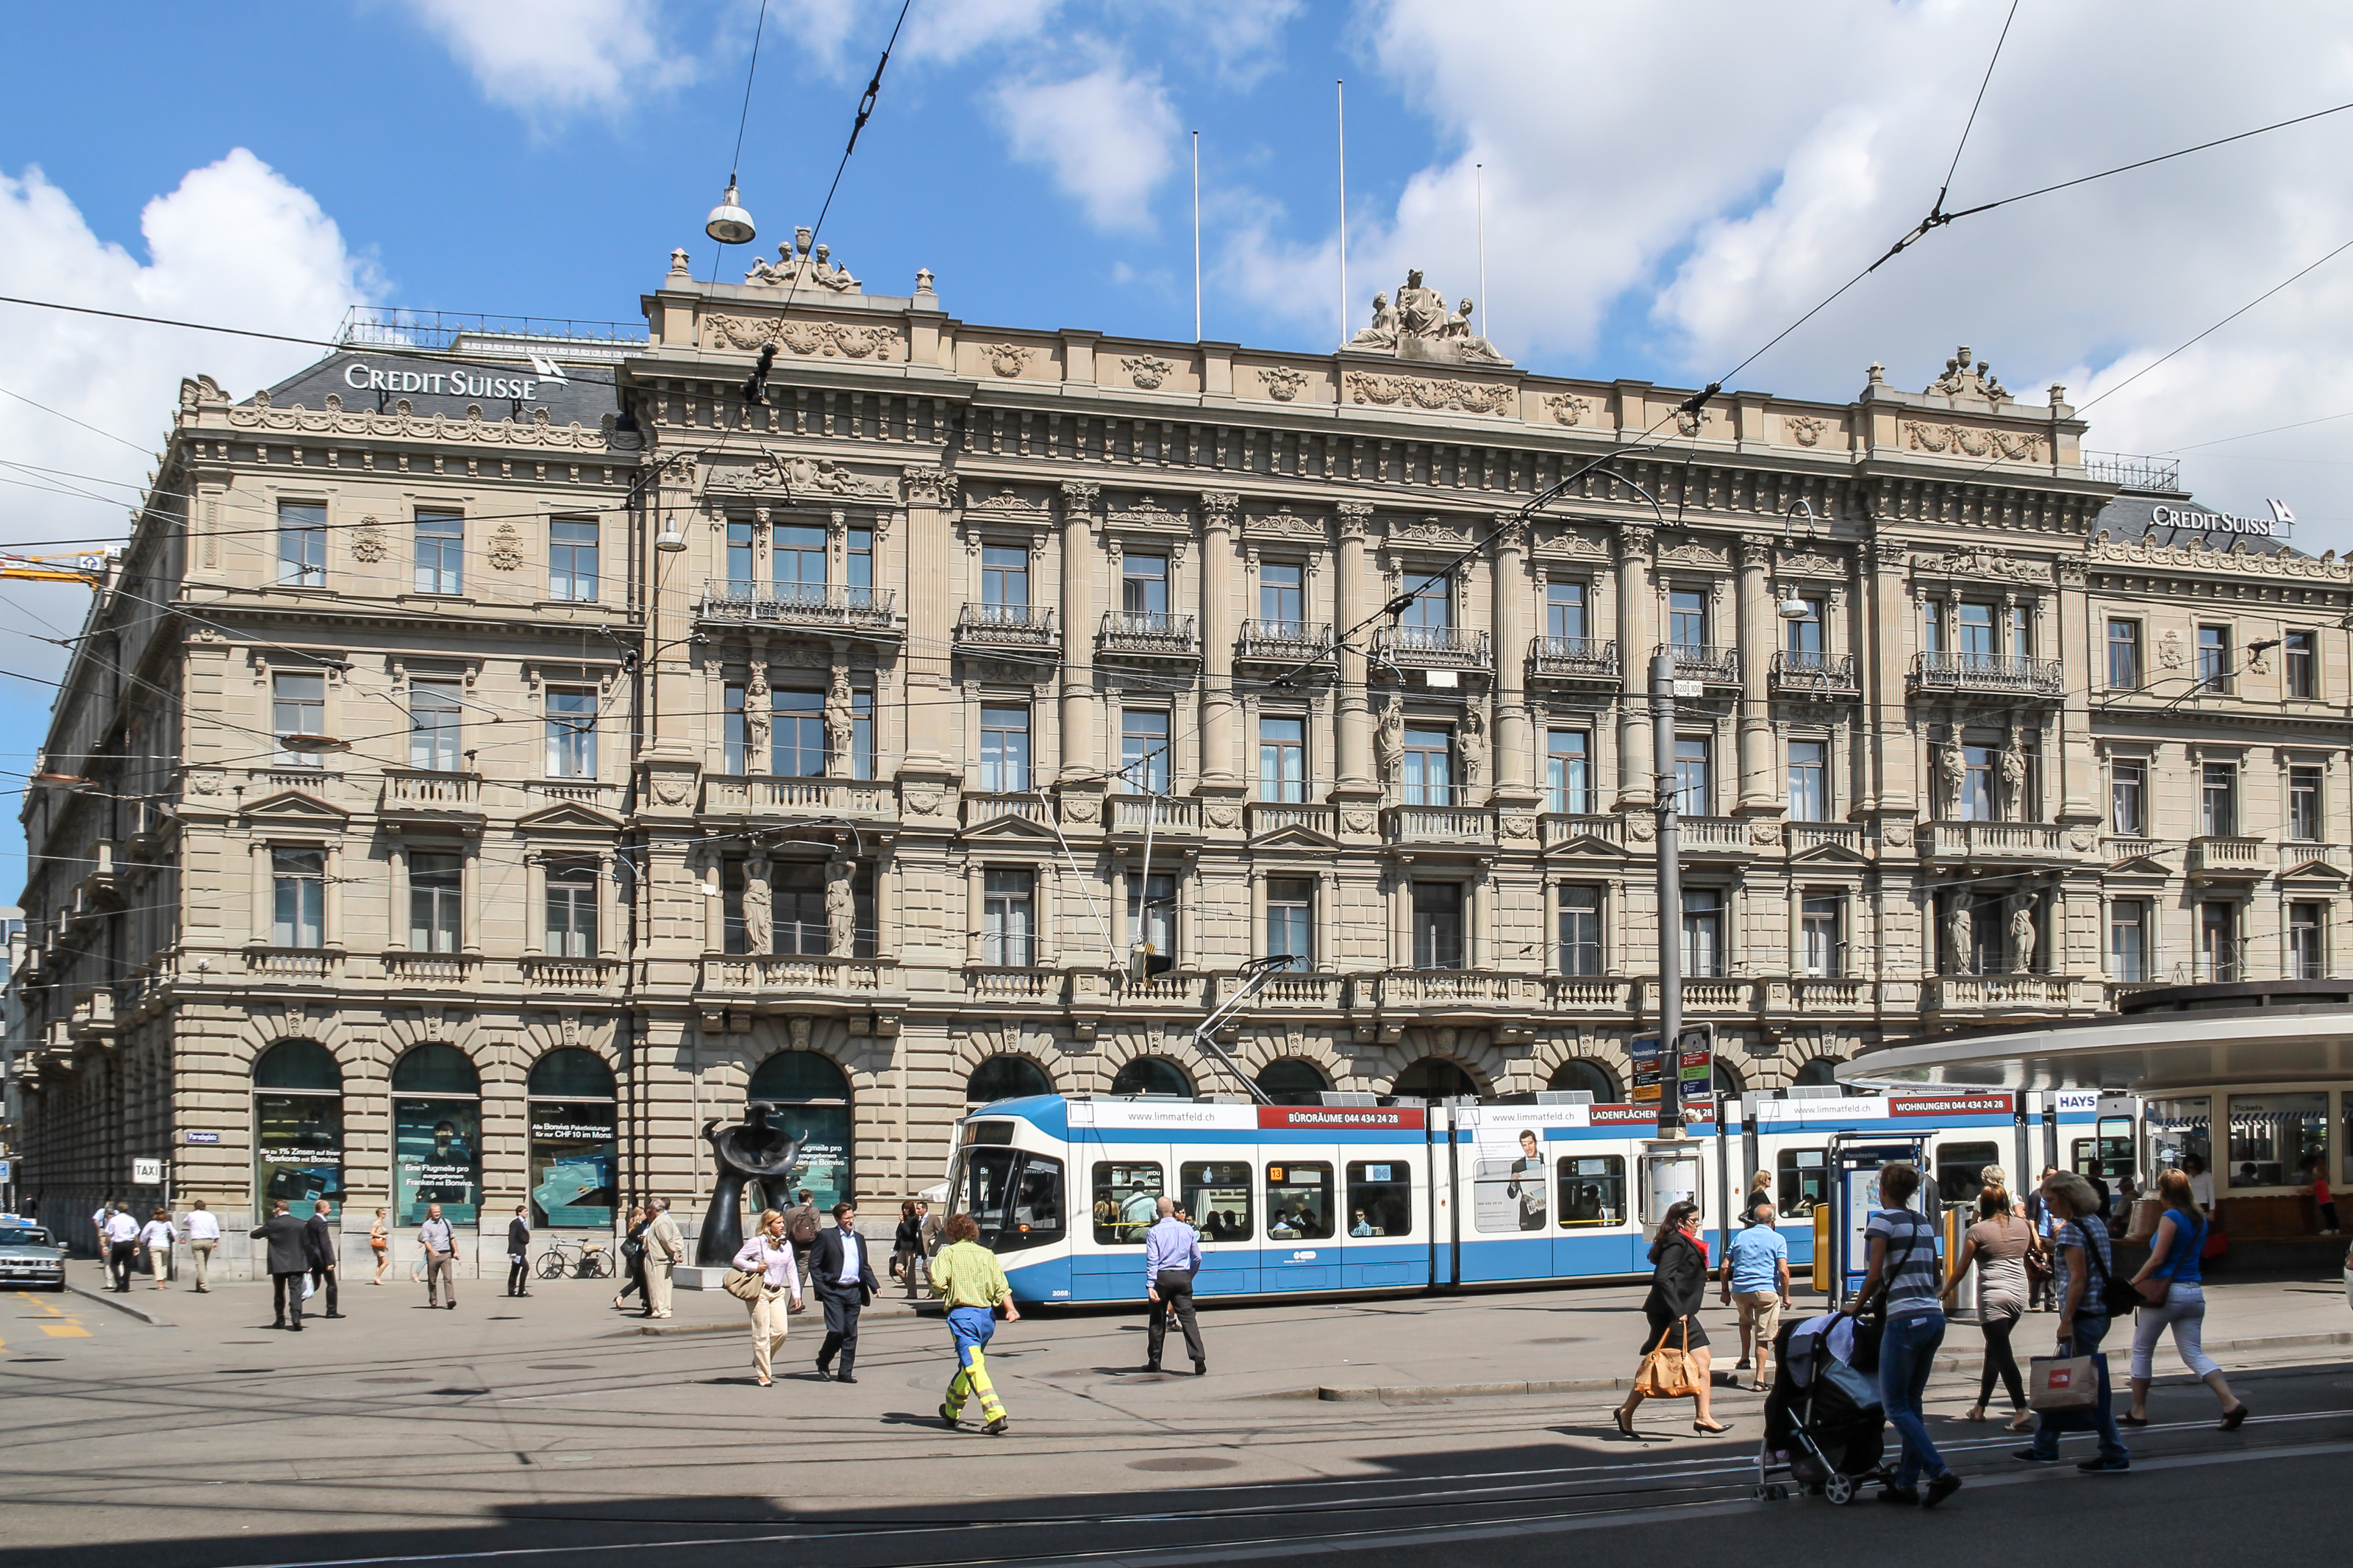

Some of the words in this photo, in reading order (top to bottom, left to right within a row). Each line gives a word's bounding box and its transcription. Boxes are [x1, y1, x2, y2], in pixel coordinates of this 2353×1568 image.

[345, 364, 446, 394] CREDIT
[450, 370, 537, 401] SUISSE
[2153, 506, 2219, 531] CREDIT
[2221, 512, 2278, 537] SUISSE
[1675, 684, 1702, 693] 5201.100
[1633, 1049, 1656, 1057] Paradeplatz
[1684, 1056, 1688, 1064] 2
[1636, 1063, 1640, 1071] 6
[1684, 1070, 1688, 1078] 8
[1637, 1076, 1640, 1084] 7
[1684, 1084, 1688, 1092] 9
[1635, 1089, 1640, 1098] 13
[1896, 1102, 1949, 1111] WOHNUNGEN
[1952, 1102, 1965, 1110] 044
[1968, 1100, 1982, 1109] 434
[1983, 1100, 1992, 1109] 24
[1994, 1100, 2004, 1108] 28
[2060, 1096, 2096, 1107] HAYS
[1794, 1104, 1871, 1114] www.limmatfeld.ch
[1129, 1111, 1215, 1122] www.limmatfeld.ch
[1288, 1111, 1343, 1123] BÜRORÄUME
[1345, 1114, 1360, 1123] 044
[1361, 1114, 1376, 1123] 434
[1377, 1114, 1387, 1123] 24
[1388, 1114, 1399, 1123] 28
[1492, 1112, 1575, 1122] www.limmatfeld.ch
[1591, 1109, 1657, 1120] LADENFLÄCHEN
[1702, 1109, 1713, 1117] 28
[801, 1145, 829, 1153] ugmeile
[265, 1155, 301, 1164] Sparkonto
[135, 1165, 158, 1176] TAXI
[422, 1164, 455, 1173] Flugmeile
[1272, 1170, 1281, 1178] 13
